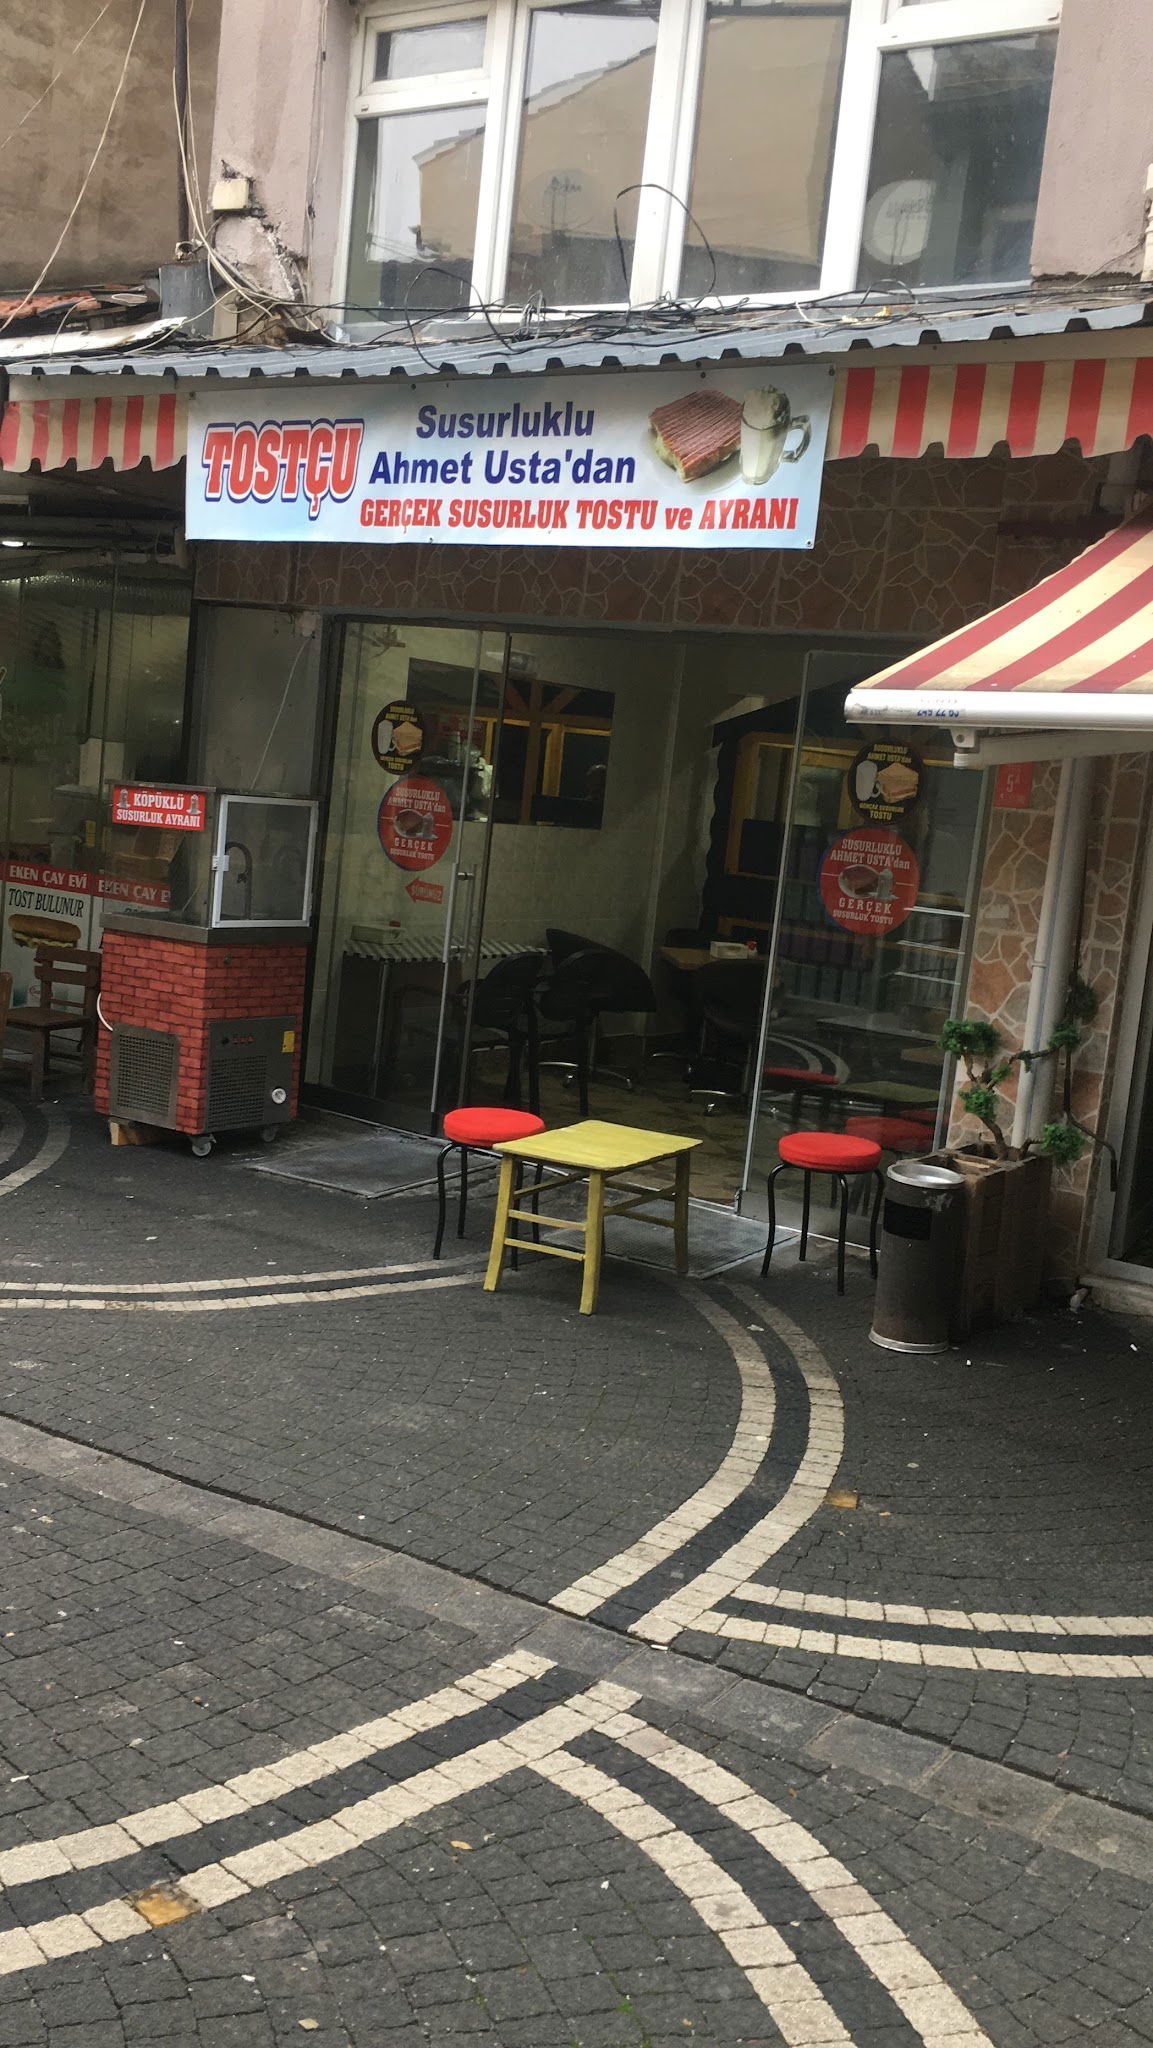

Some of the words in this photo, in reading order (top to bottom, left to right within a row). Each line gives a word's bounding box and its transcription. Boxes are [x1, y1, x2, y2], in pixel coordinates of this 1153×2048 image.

[416, 401, 595, 439] Susurluklu
[202, 418, 364, 521] TOSTÇU
[368, 451, 473, 485] Ahmet
[484, 449, 636, 485] Usta'dan
[360, 499, 441, 533] GERÇEK
[447, 499, 570, 530] SUSURLUK
[576, 500, 658, 530] TOSTU
[664, 507, 692, 530] ve
[699, 498, 799, 530] AYRANI
[133, 791, 184, 810] KÖPÜKLÜ
[116, 809, 163, 824] SUSURLUK
[165, 814, 200, 827] AYRANI
[842, 839, 902, 855] SUSURLUKLU
[830, 849, 865, 863] AHMET
[866, 854, 910, 869] USTA'dan
[9, 865, 39, 881] EKEN
[42, 870, 65, 887] ÇAY
[68, 873, 88, 889] EVİ
[9, 888, 34, 909] TOST
[35, 891, 85, 918] BULUNUR
[839, 897, 892, 914] GERÇEK
[832, 909, 869, 921] SUSURLUK
[870, 915, 893, 925] TOSTU
